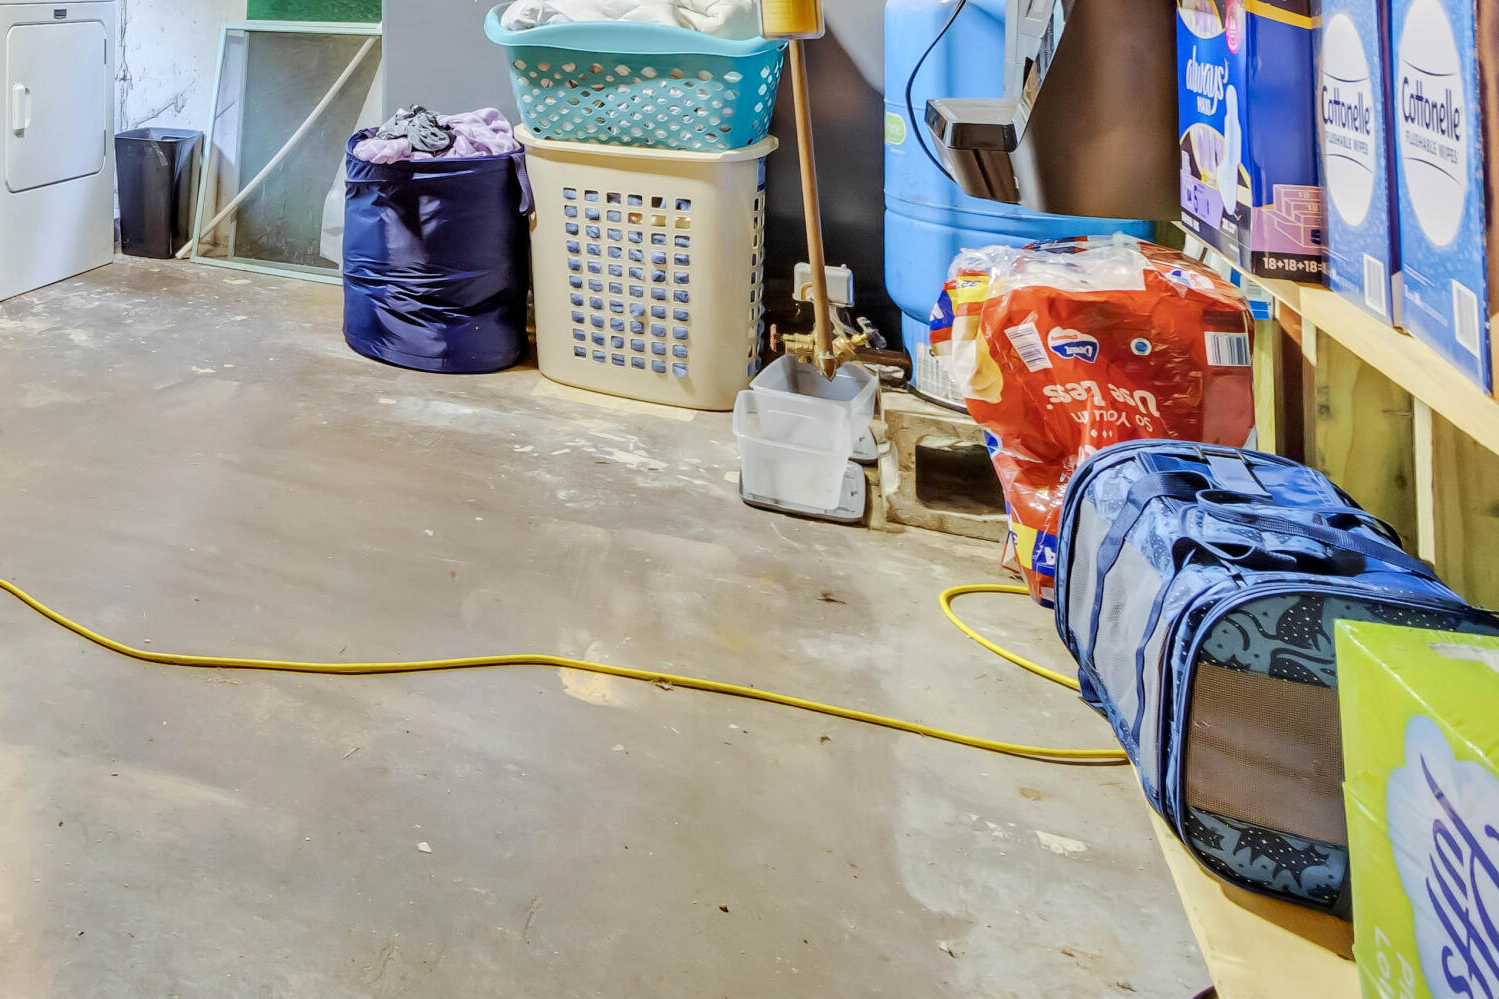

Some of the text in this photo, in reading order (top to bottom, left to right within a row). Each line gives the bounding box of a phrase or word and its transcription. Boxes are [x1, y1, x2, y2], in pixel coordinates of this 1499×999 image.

[1321, 85, 1370, 136] Cottonelle
[1402, 76, 1460, 142] Cottonelle
[1042, 380, 1160, 418] Use Less
[1094, 409, 1132, 428] You
